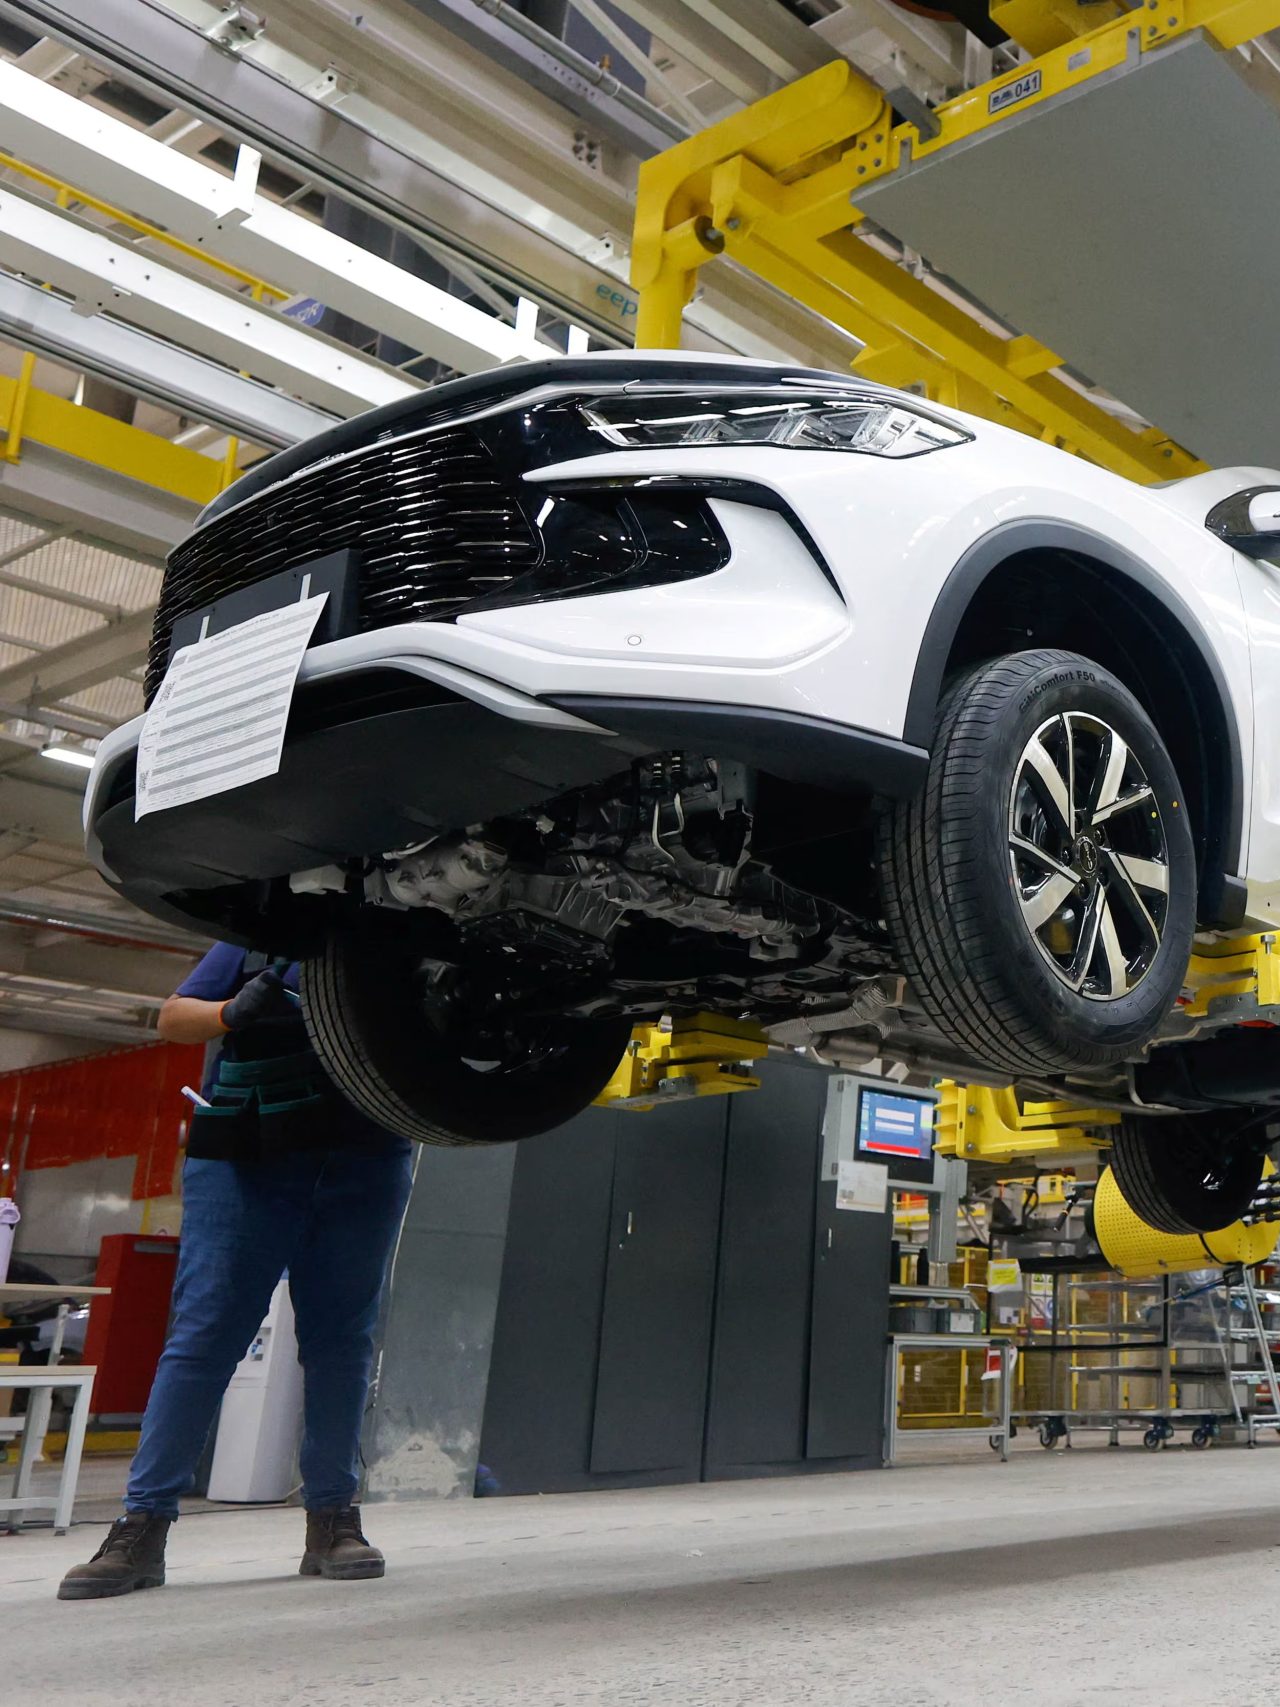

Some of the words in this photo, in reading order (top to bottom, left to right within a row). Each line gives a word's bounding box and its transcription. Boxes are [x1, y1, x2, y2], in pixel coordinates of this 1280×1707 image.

[1015, 75, 1038, 98] 041
[595, 283, 638, 316] eep
[1077, 670, 1096, 682] F50
